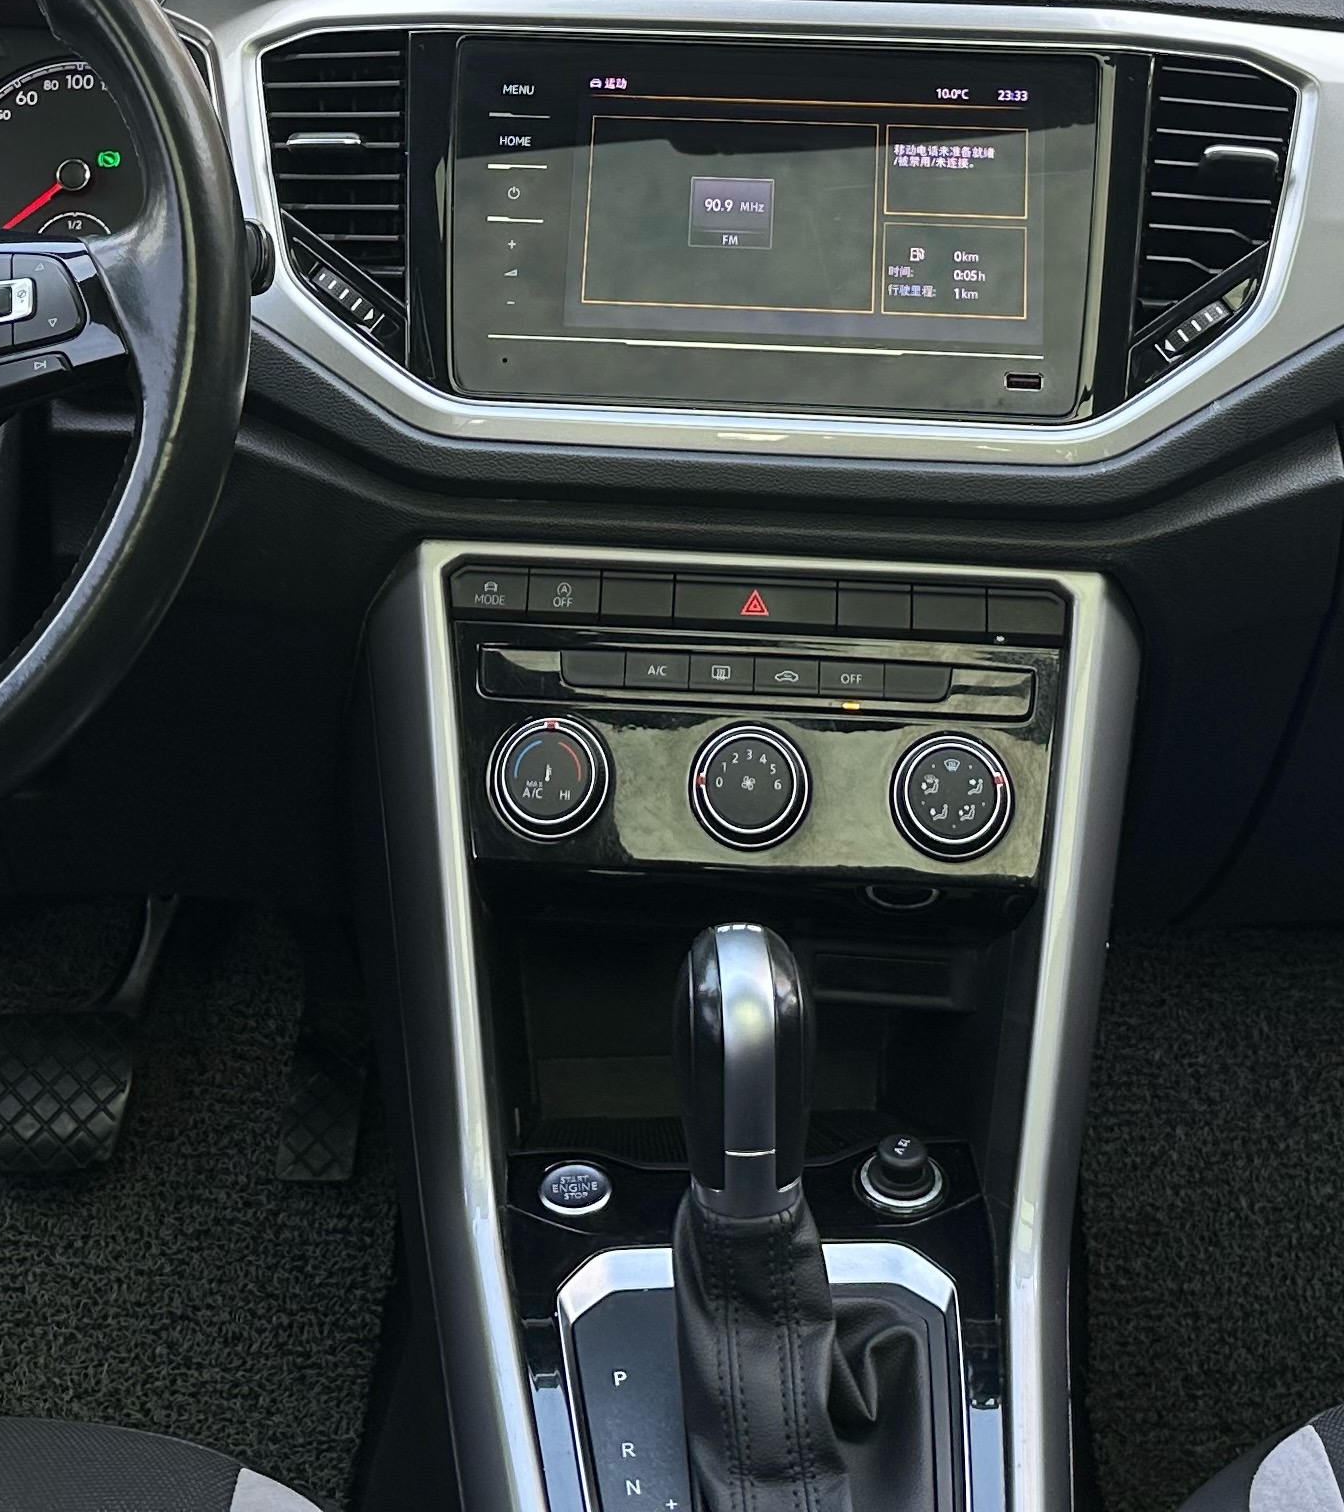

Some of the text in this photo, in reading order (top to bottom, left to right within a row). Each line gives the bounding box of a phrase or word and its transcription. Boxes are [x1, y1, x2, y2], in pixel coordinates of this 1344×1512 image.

[43, 80, 59, 90] 80
[65, 74, 94, 89] 100
[502, 84, 534, 95] MENU
[997, 90, 1028, 101] 23:33
[15, 91, 38, 105] 60
[499, 135, 532, 147] HOME
[704, 198, 765, 213] 90.9 MHz
[67, 219, 82, 230] 1/2
[722, 234, 739, 246] FM
[474, 594, 506, 605] MODE
[552, 596, 573, 608] OFF
[647, 665, 668, 676] A/C
[840, 673, 863, 685] OFF
[731, 752, 739, 764] 2
[746, 748, 753, 760] 3
[759, 753, 768, 764] 4
[721, 761, 727, 773] 1
[769, 763, 777, 775] 5
[715, 776, 723, 788] 0
[774, 778, 782, 790] 6
[522, 787, 544, 799] A/C
[559, 789, 571, 800] HI
[559, 1174, 590, 1184] START
[552, 1180, 598, 1193] ENGINE
[563, 1191, 589, 1200] STOP
[613, 1370, 628, 1387] P
[621, 1442, 636, 1458] R
[625, 1479, 642, 1496] N
